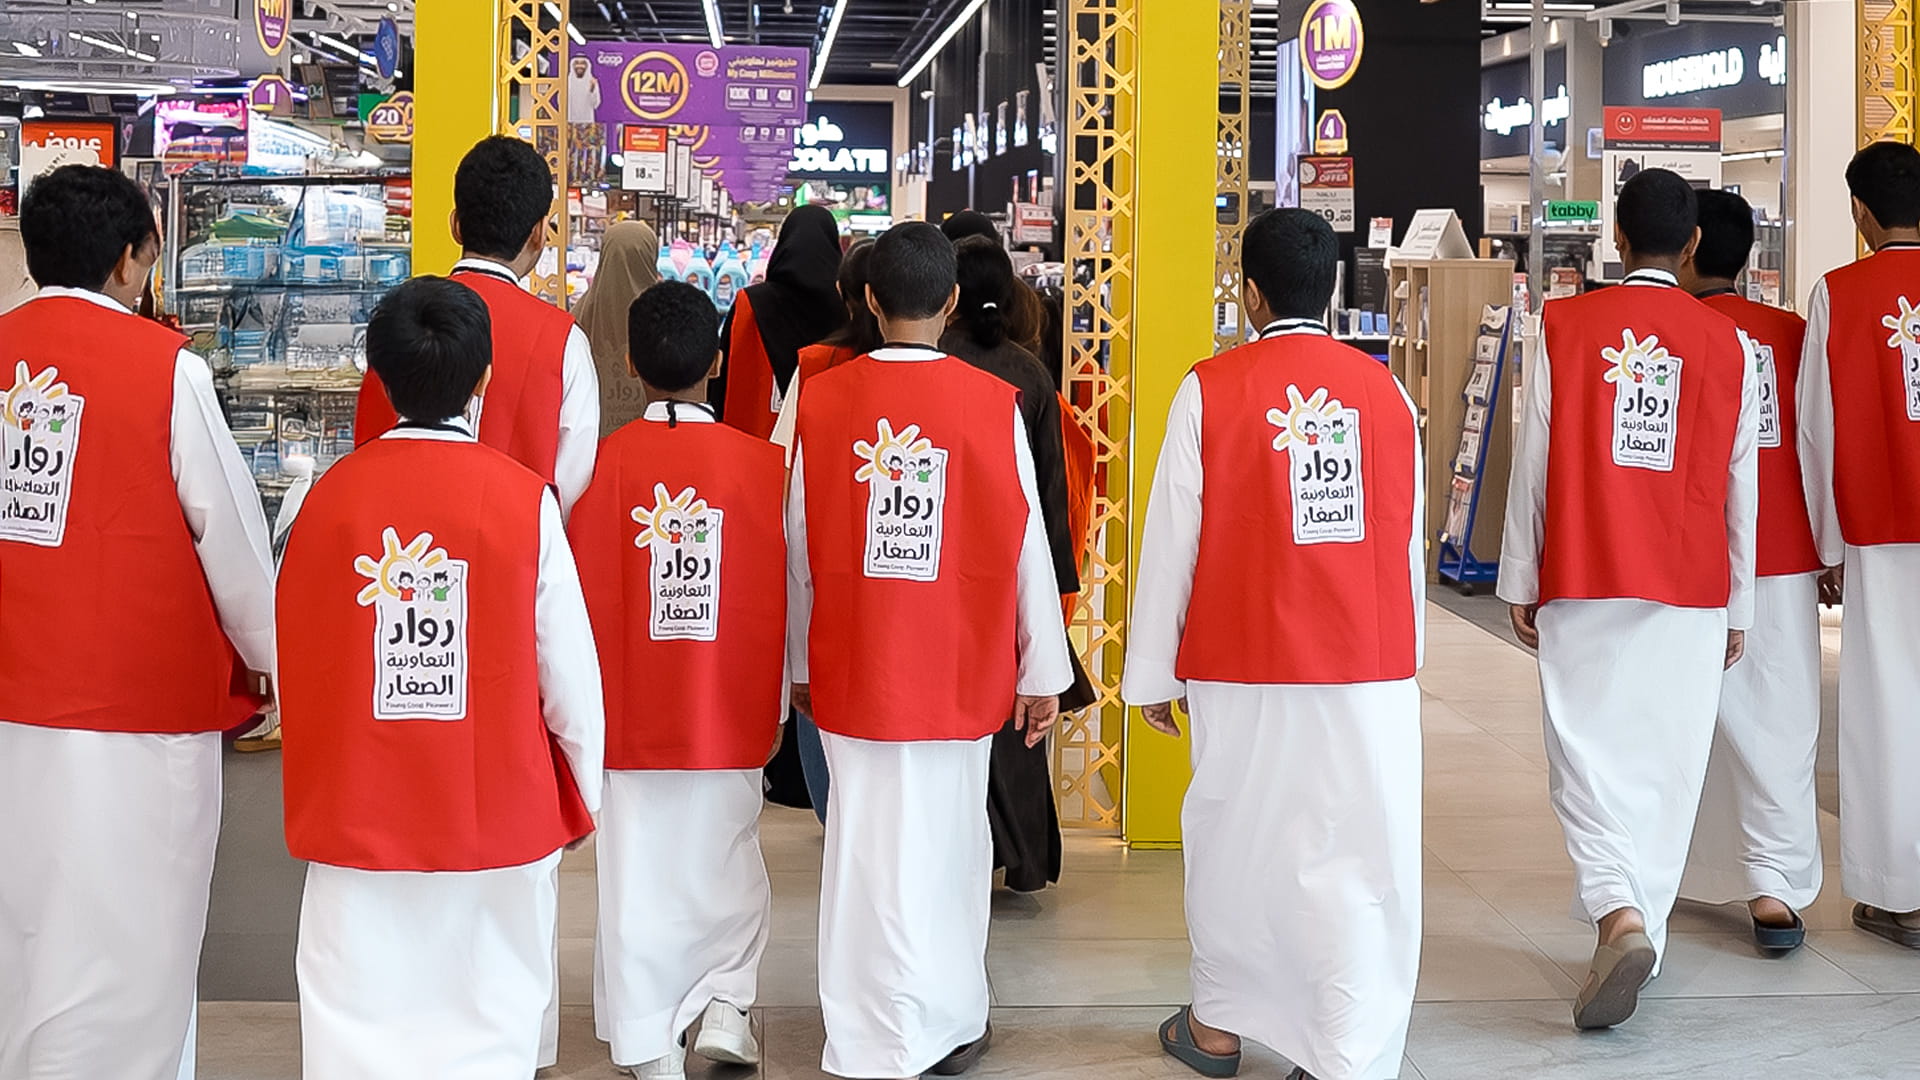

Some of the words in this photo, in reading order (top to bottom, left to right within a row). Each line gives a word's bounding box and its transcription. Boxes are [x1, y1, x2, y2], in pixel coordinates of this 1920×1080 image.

[1309, 14, 1351, 52] 1M
[630, 70, 680, 93] 12M
[1643, 47, 1743, 98] HOUSEHOLD
[265, 83, 276, 104] 1
[375, 109, 399, 125] 20
[1324, 118, 1335, 138] 4
[1551, 204, 1594, 219] tabby
[1623, 387, 1669, 418] رواد
[1300, 449, 1352, 483] رواد
[878, 485, 934, 521] رواد
[661, 547, 711, 581] رواد
[388, 606, 455, 648] رواد
